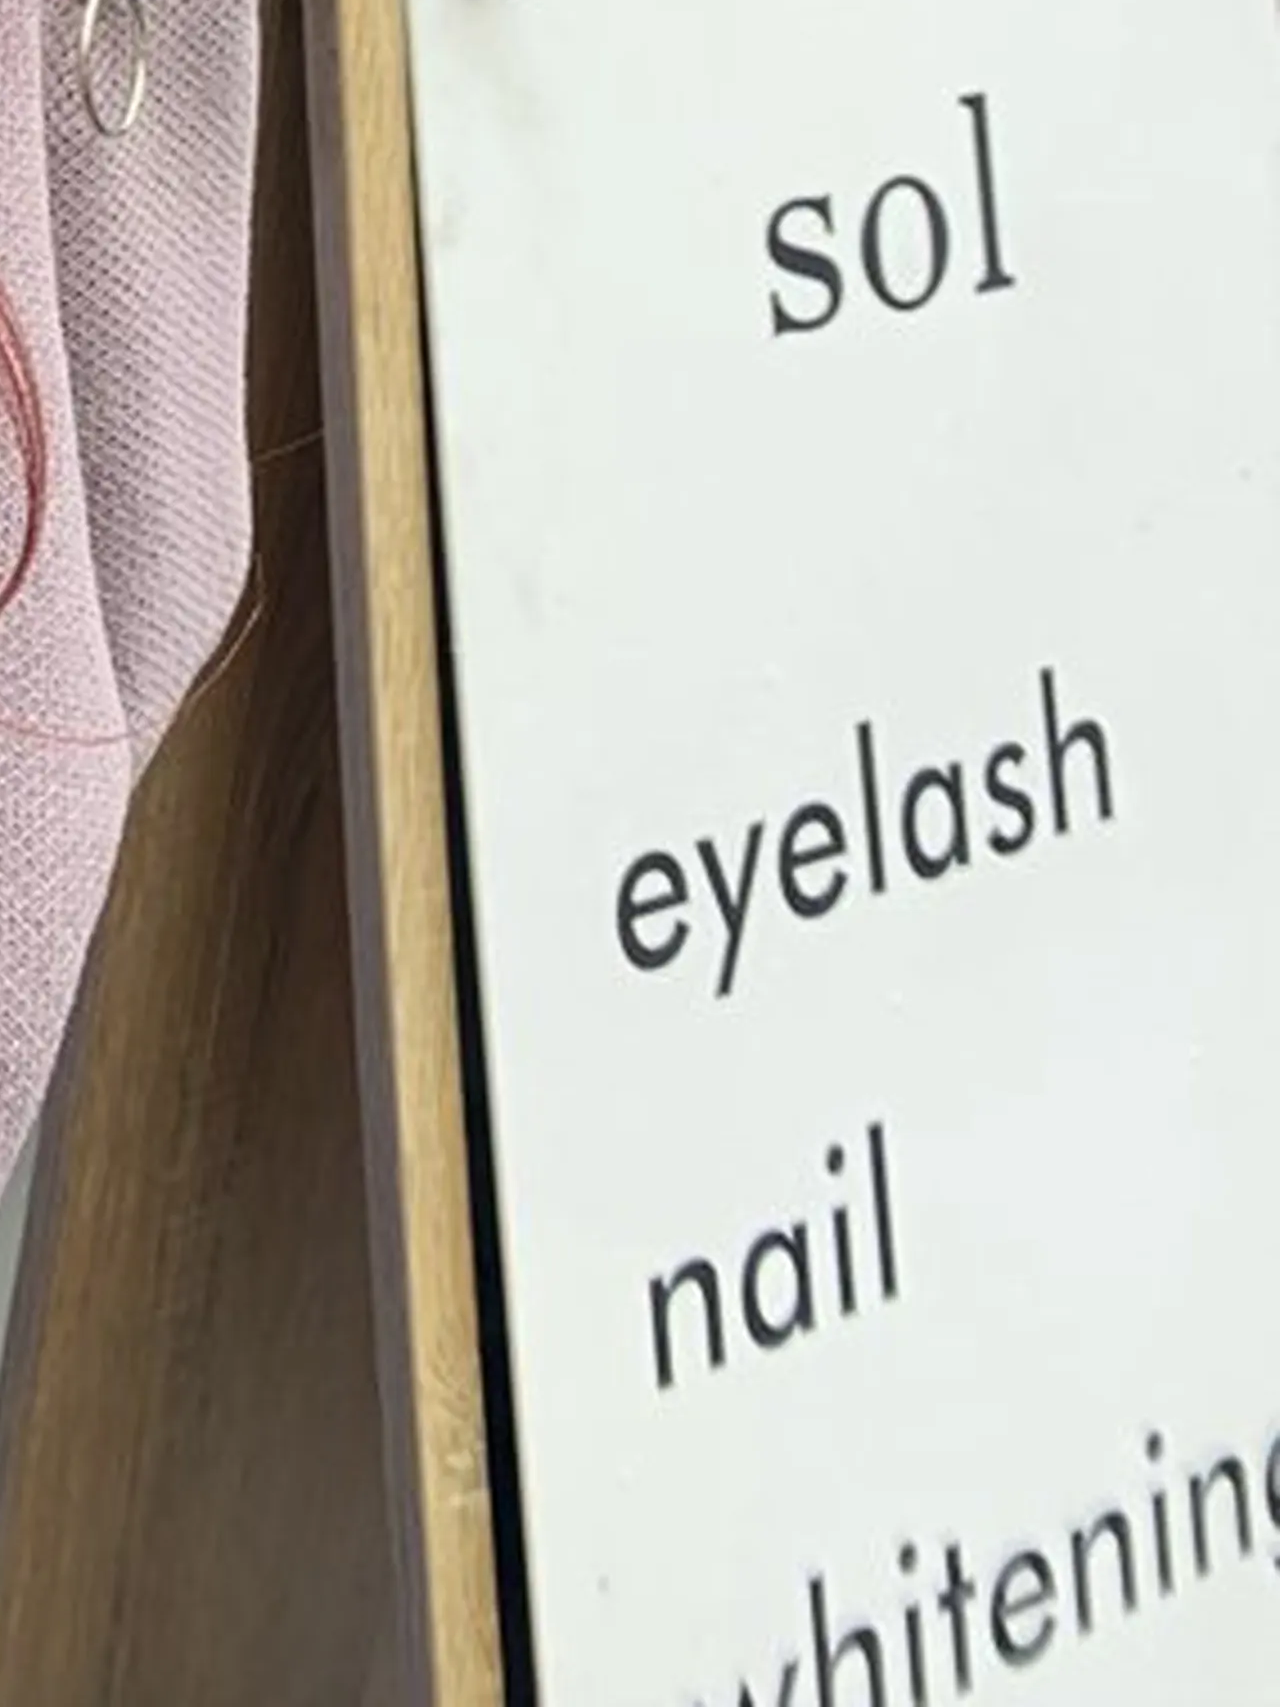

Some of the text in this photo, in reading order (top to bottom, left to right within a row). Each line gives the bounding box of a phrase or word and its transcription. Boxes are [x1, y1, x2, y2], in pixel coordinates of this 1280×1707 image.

[764, 91, 1016, 338] sol
[614, 666, 1115, 999] eyelash
[647, 1121, 899, 1391] nail
[694, 1430, 1280, 1707] hitenin
